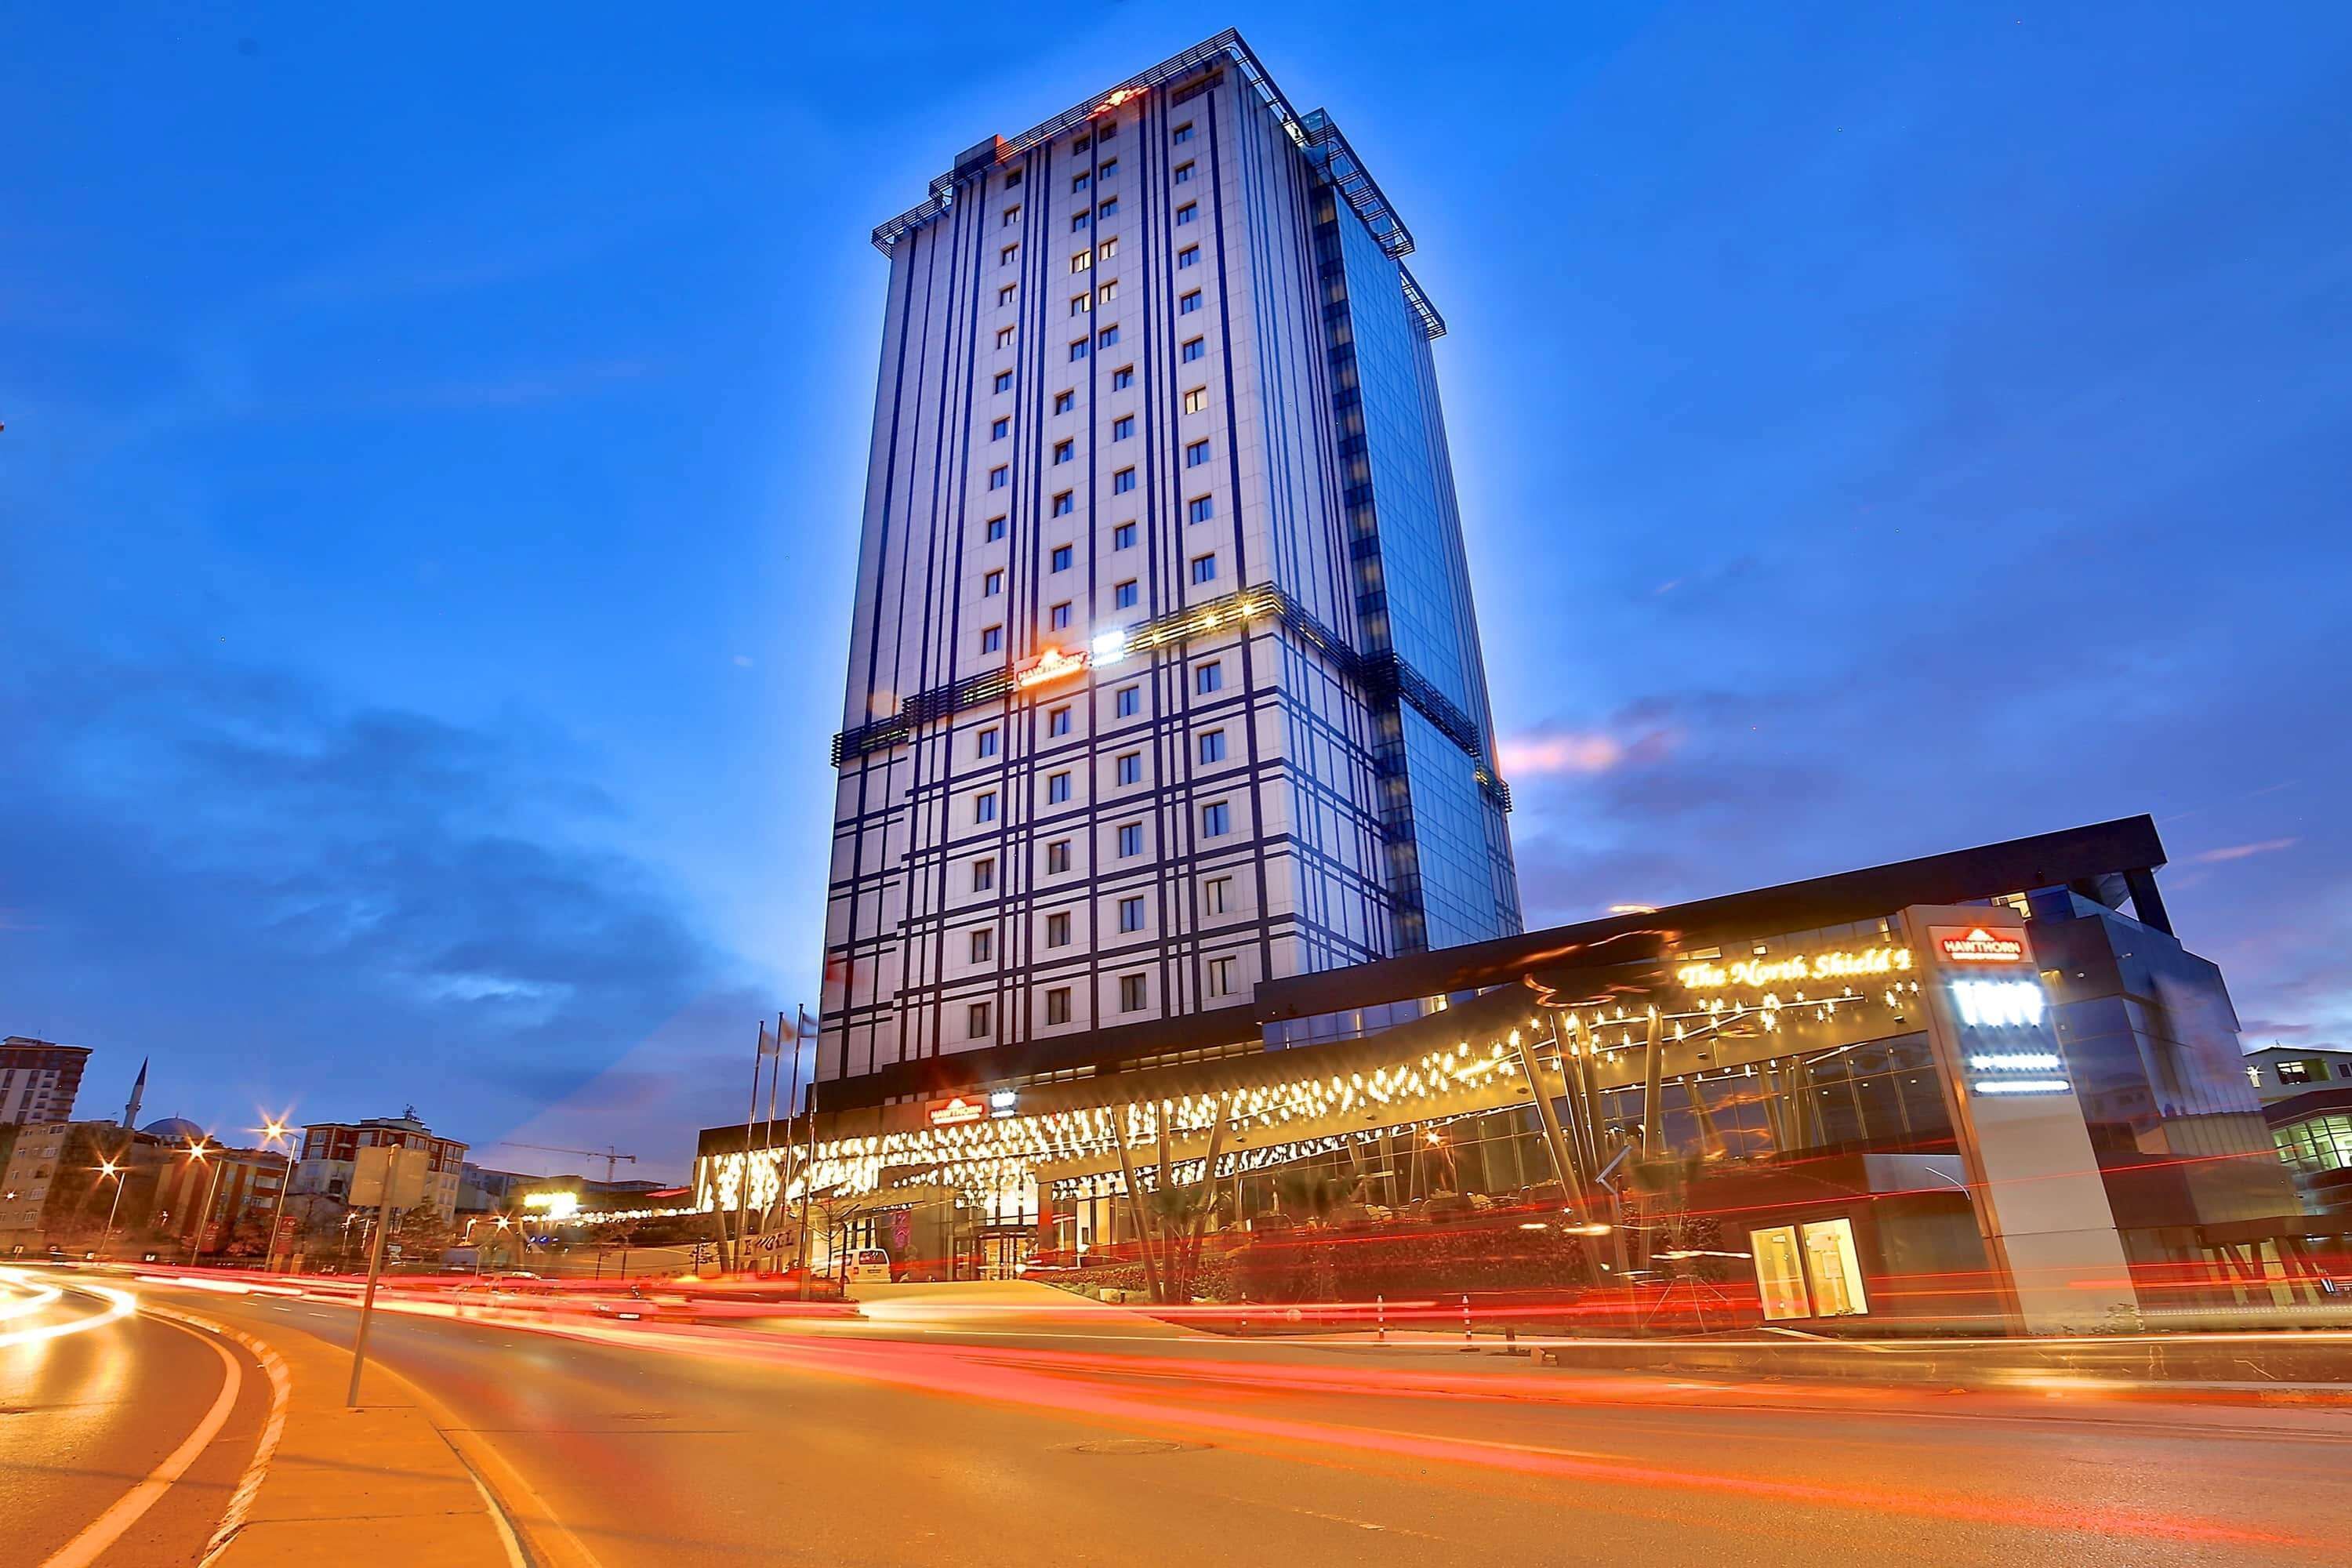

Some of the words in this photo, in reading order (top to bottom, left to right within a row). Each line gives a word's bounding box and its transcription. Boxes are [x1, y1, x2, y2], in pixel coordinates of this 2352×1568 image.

[1944, 940, 2021, 953] HAWTHORN
[1677, 963, 1727, 989] The
[1730, 956, 1808, 987] North
[1812, 947, 1893, 979] Shield
